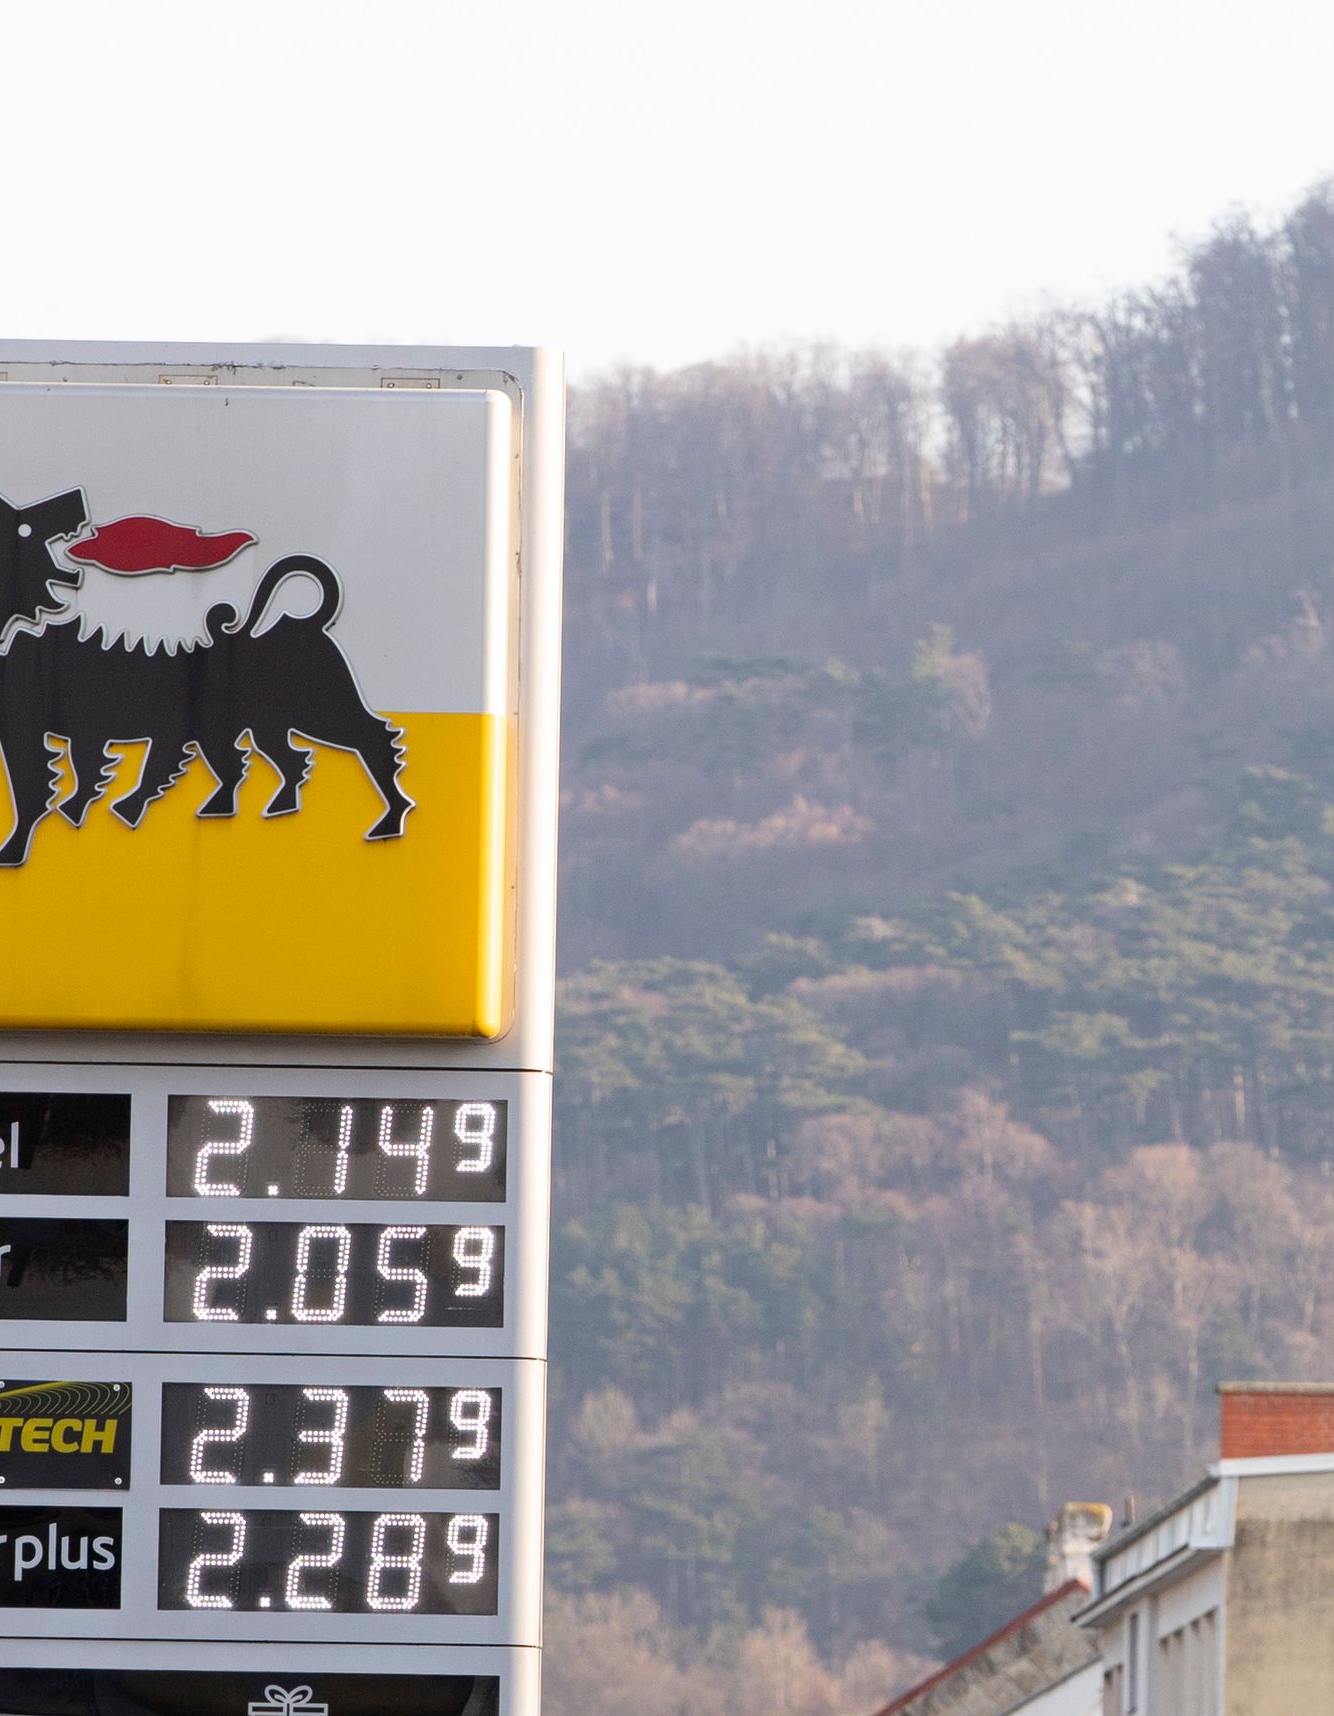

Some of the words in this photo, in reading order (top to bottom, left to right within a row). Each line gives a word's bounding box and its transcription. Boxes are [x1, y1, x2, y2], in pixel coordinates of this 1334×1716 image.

[194, 1099, 496, 1197] 2.149
[192, 1224, 494, 1322] 2.059
[190, 1387, 492, 1484] 2.379
[186, 1511, 489, 1609] 2.289
